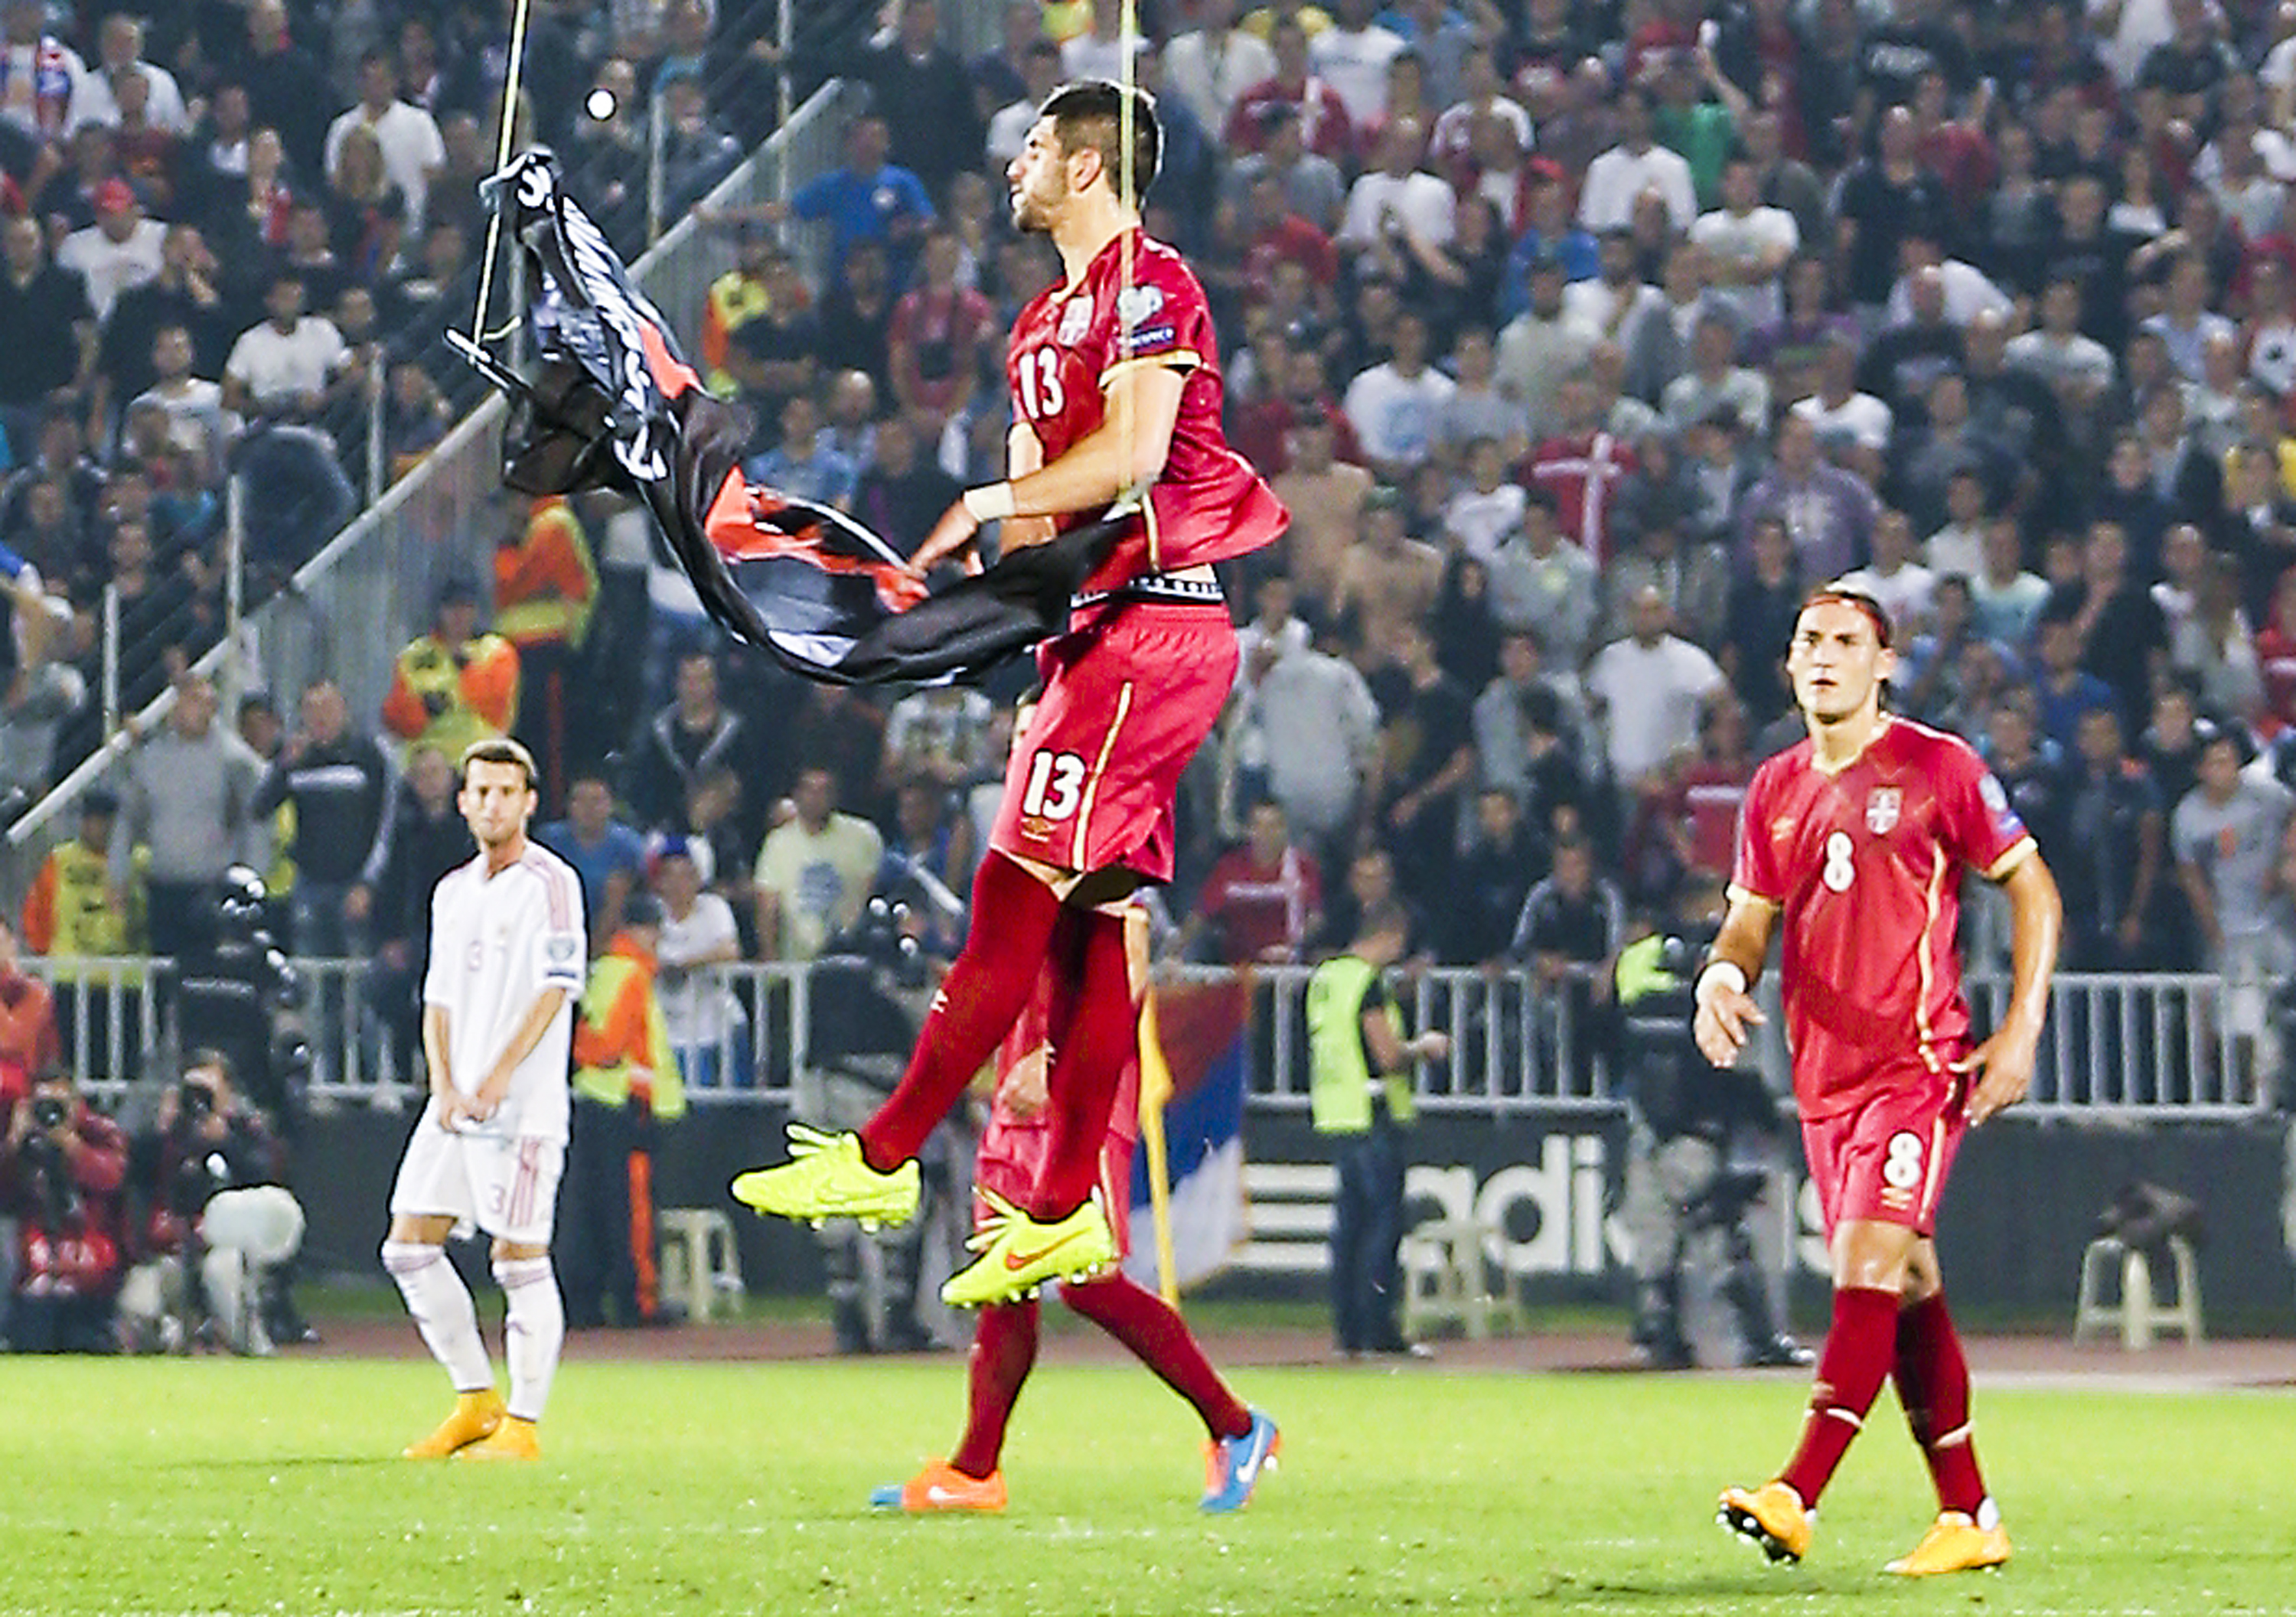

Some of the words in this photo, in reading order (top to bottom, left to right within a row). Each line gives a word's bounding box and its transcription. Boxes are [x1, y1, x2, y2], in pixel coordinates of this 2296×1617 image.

[1019, 347, 1065, 419] 13
[1023, 751, 1085, 820] 13
[1823, 831, 1854, 892] 8
[1883, 1133, 1923, 1187] 8
[490, 1183, 506, 1214] 3
